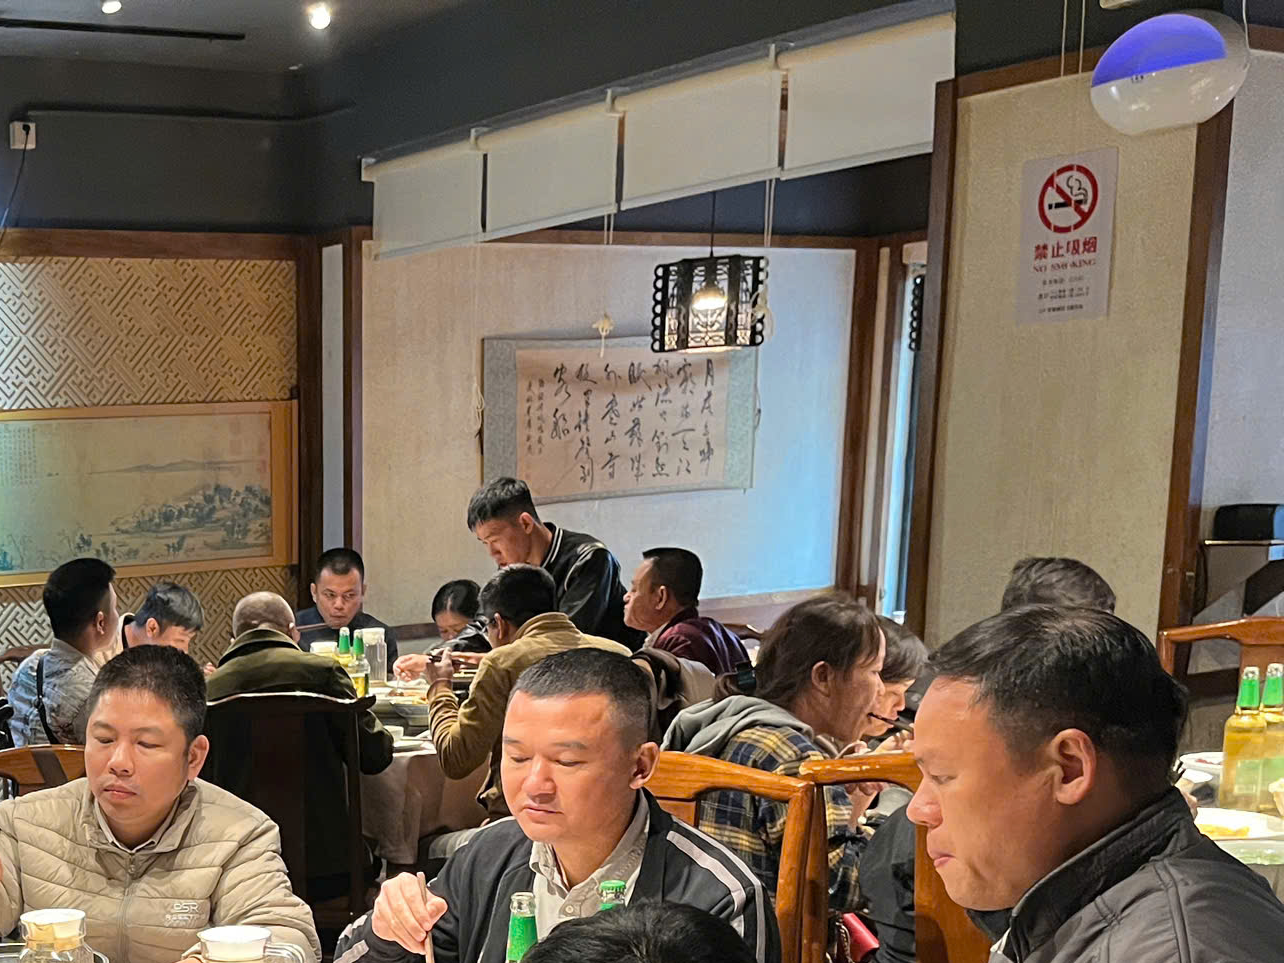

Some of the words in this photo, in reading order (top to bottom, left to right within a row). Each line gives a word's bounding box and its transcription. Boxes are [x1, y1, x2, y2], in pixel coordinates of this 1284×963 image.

[1034, 236, 1097, 260] 禁止吸烟
[1033, 264, 1048, 272] NO
